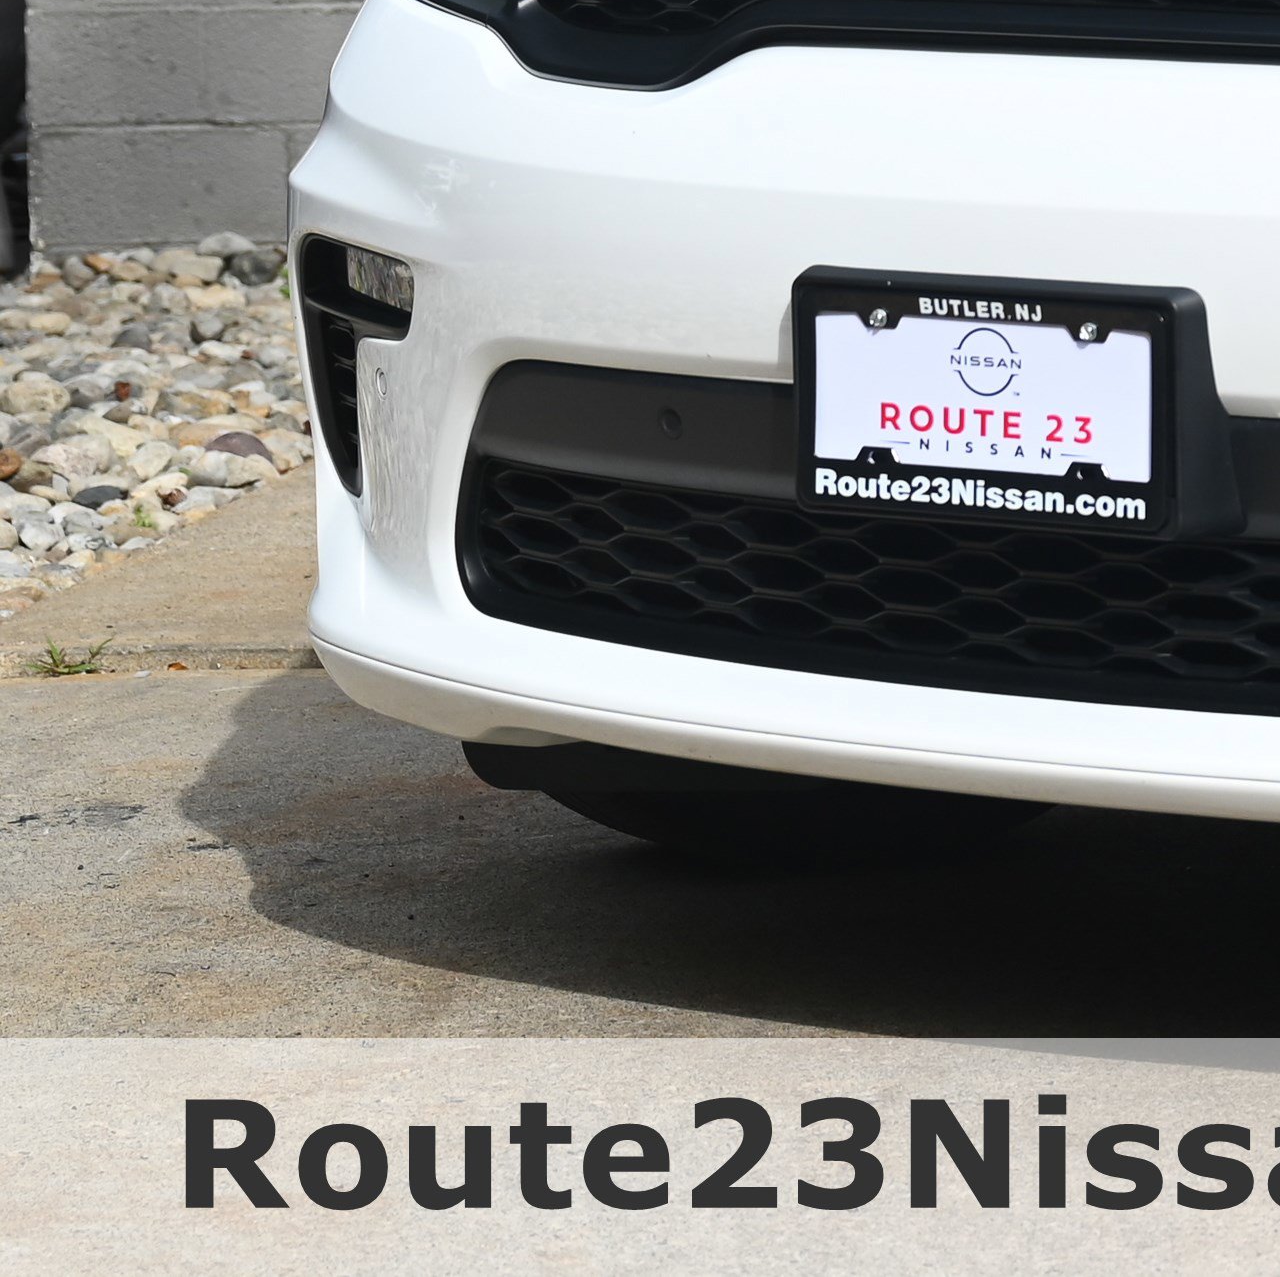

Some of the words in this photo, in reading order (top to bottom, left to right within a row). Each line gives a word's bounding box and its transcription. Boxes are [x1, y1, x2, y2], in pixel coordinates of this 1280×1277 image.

[1014, 303, 1043, 322] NJ
[950, 354, 1022, 370] NISSAN
[880, 402, 1022, 440] ROUTE
[1045, 414, 1093, 445] 23
[919, 438, 1052, 460] NISSAN
[815, 467, 1147, 521] Route23Nissan.com
